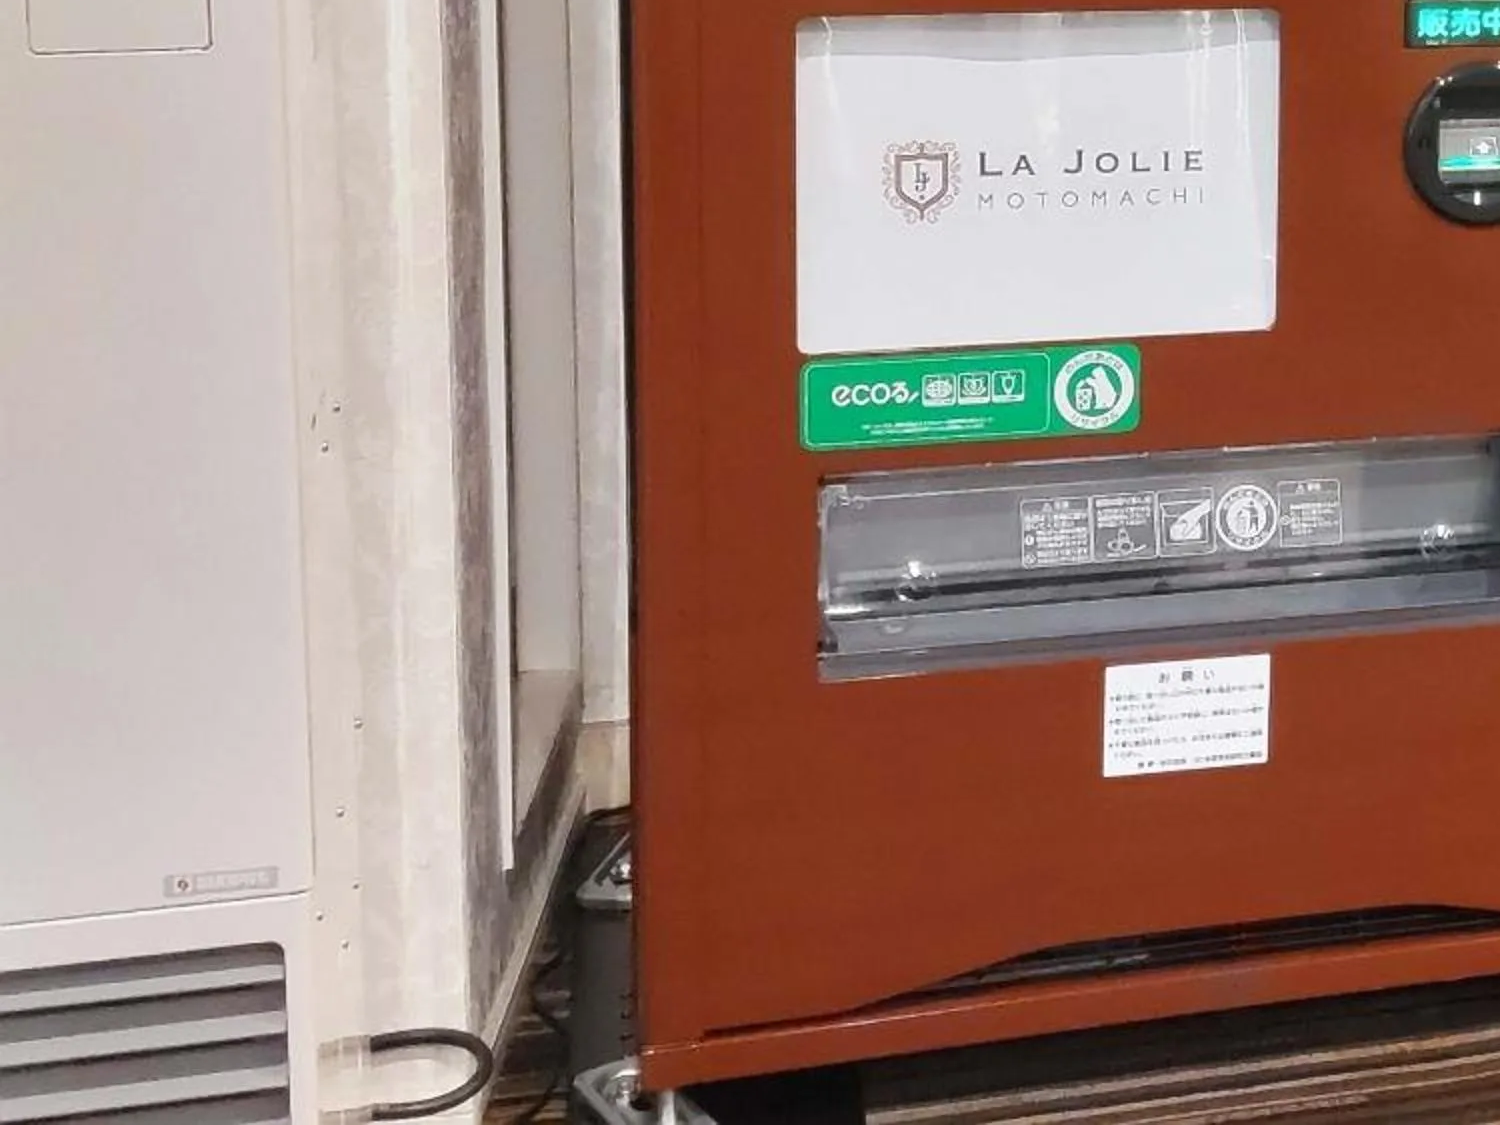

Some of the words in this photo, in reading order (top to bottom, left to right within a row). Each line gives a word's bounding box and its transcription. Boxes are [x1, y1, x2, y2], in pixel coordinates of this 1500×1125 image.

[979, 152, 1036, 177] LA
[1063, 149, 1204, 175] JOLIE
[978, 187, 1204, 211] MOTOMACHI
